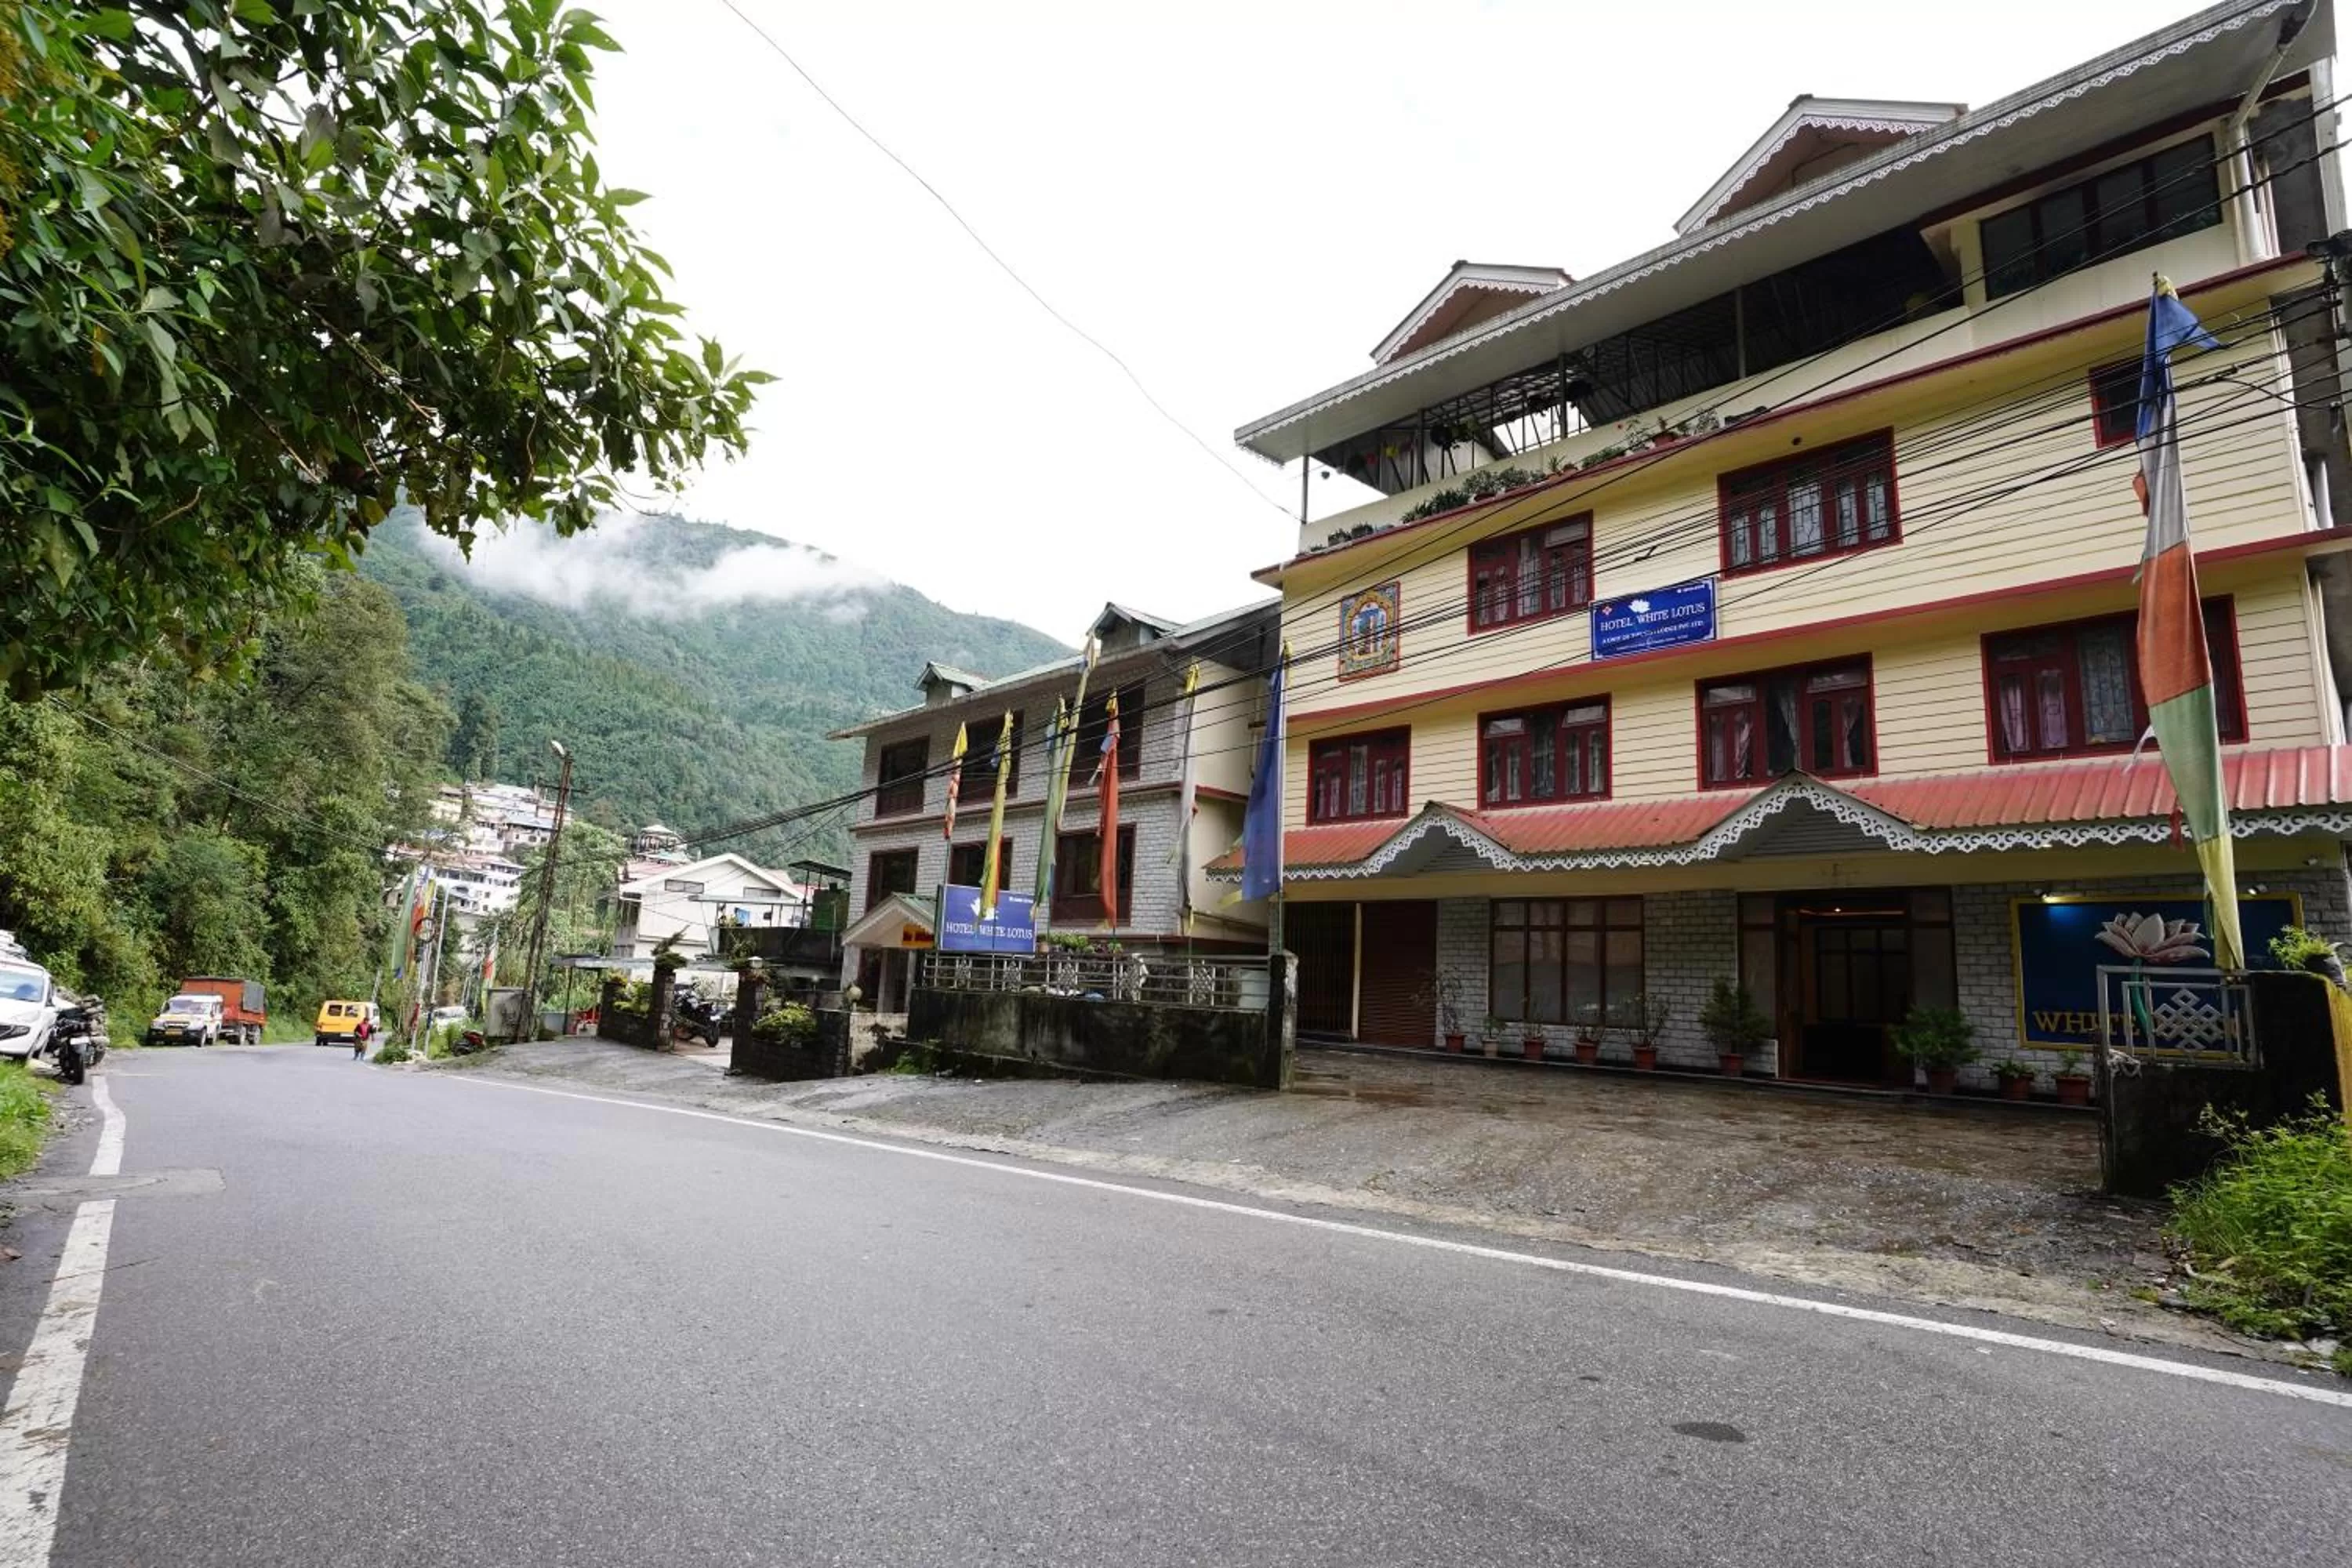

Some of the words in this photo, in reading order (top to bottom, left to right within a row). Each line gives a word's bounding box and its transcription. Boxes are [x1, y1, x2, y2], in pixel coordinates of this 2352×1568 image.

[1600, 617, 1633, 631] HOTEL
[1636, 609, 1669, 624] WHITE
[1671, 602, 1705, 619] LOTUS
[946, 922, 973, 934] HOTEL
[979, 924, 1005, 937] WHTE
[1007, 927, 1033, 940] LOTUS
